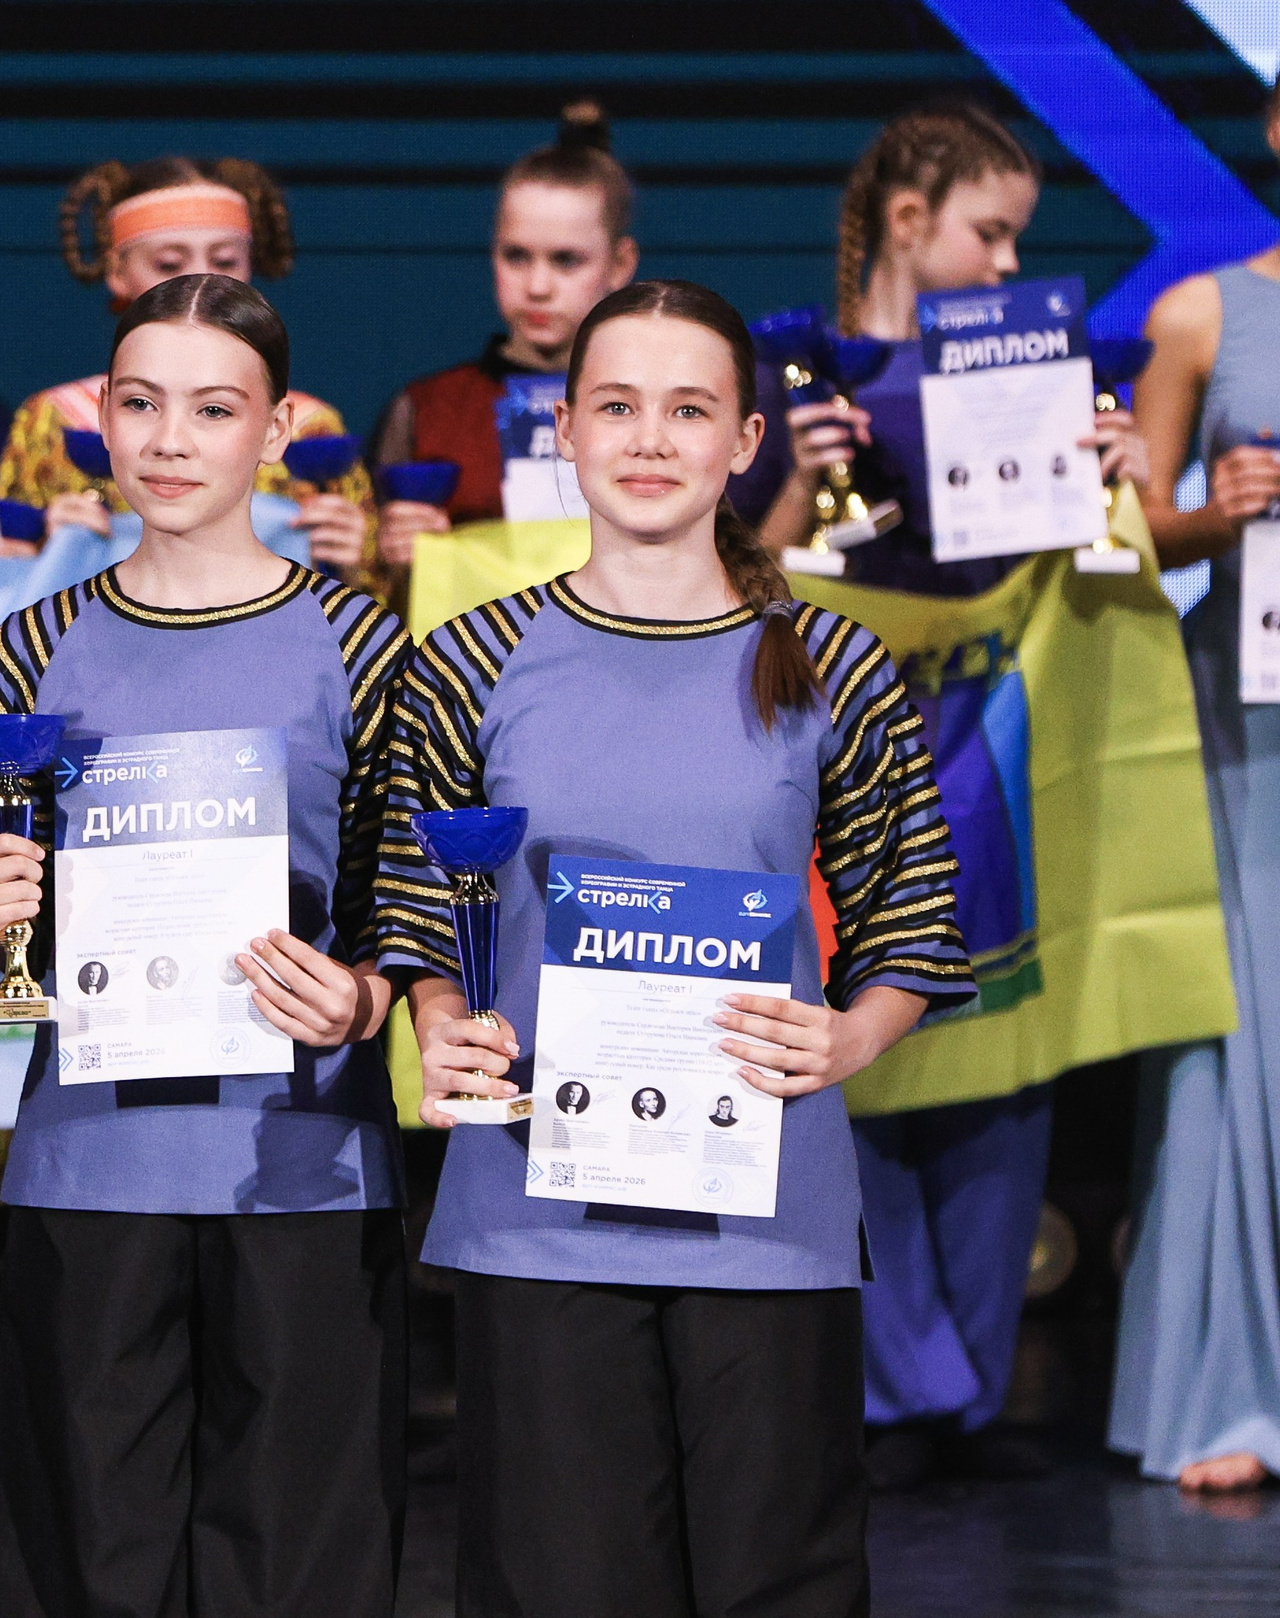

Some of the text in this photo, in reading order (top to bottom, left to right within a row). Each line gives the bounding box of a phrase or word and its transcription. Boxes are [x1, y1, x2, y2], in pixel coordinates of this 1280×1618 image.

[939, 327, 1069, 376] ДИПЛОМ
[82, 761, 167, 786] стрелка
[82, 797, 256, 843] ДИПЛОМ
[142, 850, 187, 862] Лауреат
[577, 888, 671, 915] стрелка
[573, 926, 761, 971] ДИПЛОМ
[637, 979, 686, 994] Лауреат
[107, 1051, 112, 1059] 5
[114, 1050, 143, 1058] апреля
[583, 1173, 646, 1185] 5 апреля 2026
